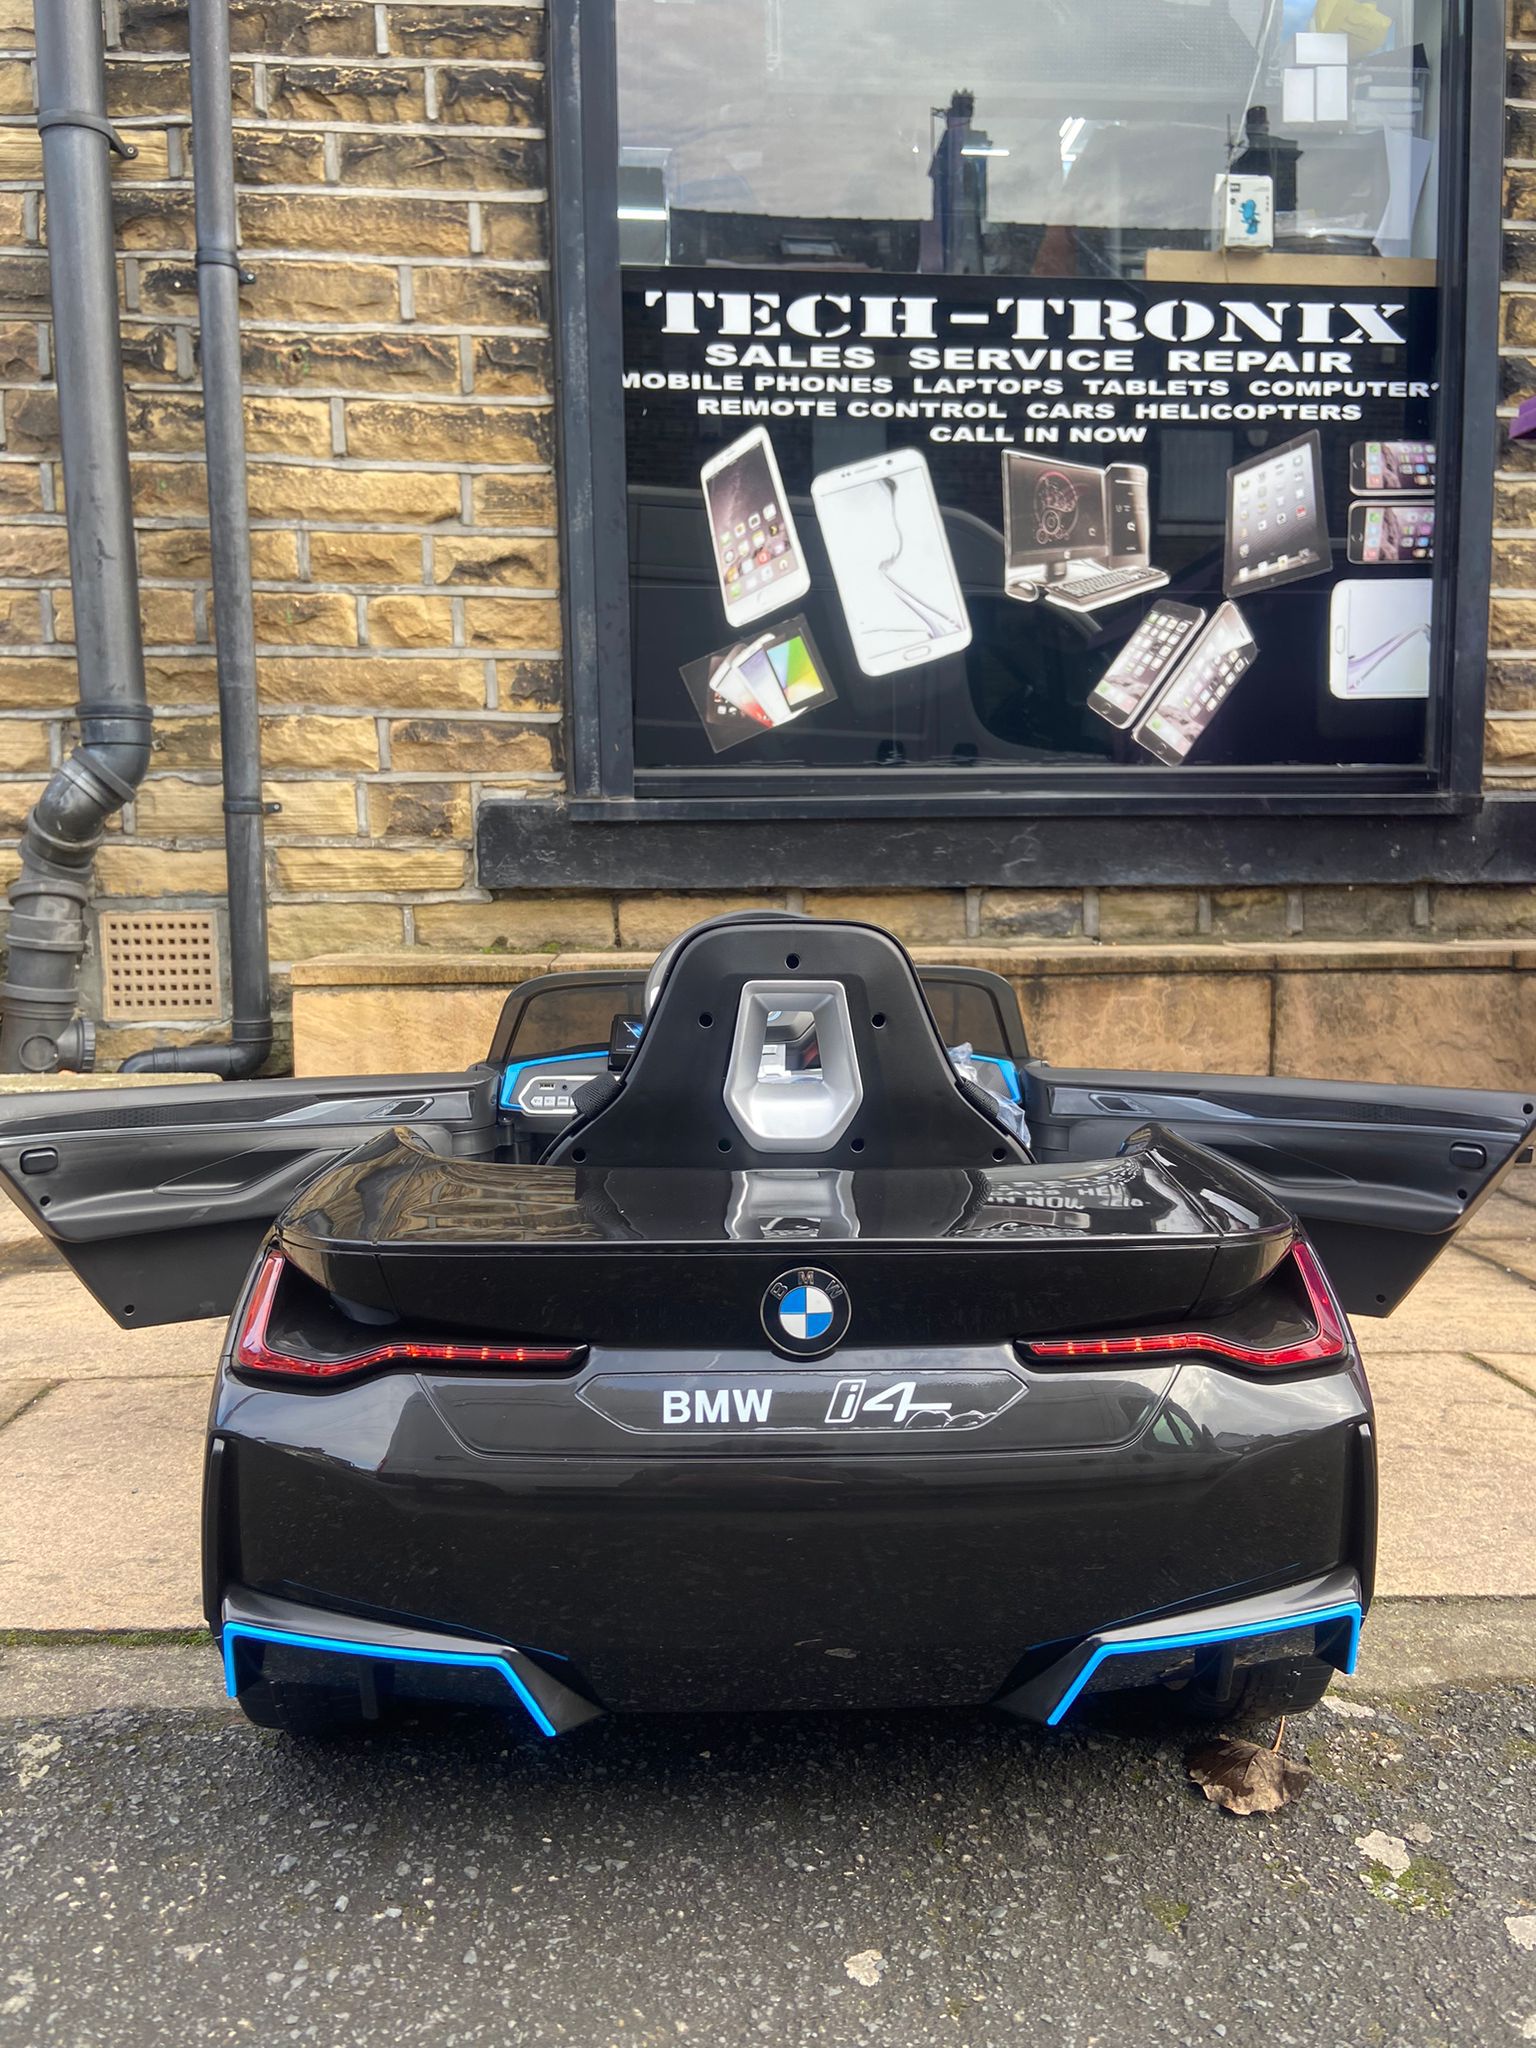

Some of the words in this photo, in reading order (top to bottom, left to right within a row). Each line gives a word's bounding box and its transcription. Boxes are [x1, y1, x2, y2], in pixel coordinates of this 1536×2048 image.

[644, 289, 1407, 344] TECH-TRONIX
[704, 342, 876, 369] SALES
[908, 346, 1135, 372] SERVICE
[1167, 349, 1354, 374] REPAIR
[622, 371, 744, 391] MOBILE
[754, 374, 893, 394] PHONES
[912, 376, 1064, 395] LAPTOPS
[1082, 378, 1230, 396] TABLETS
[696, 397, 838, 417] REMOTE
[846, 400, 1008, 419] CONTROL
[1025, 402, 1116, 420] CARS
[1134, 403, 1363, 421] HELICOPTERS
[929, 425, 1015, 444] CALL
[1024, 426, 1059, 444] IN
[1068, 426, 1148, 444] NOW
[769, 1270, 843, 1300] BMW
[661, 1388, 774, 1425] BMW
[823, 1378, 953, 1424] i4
